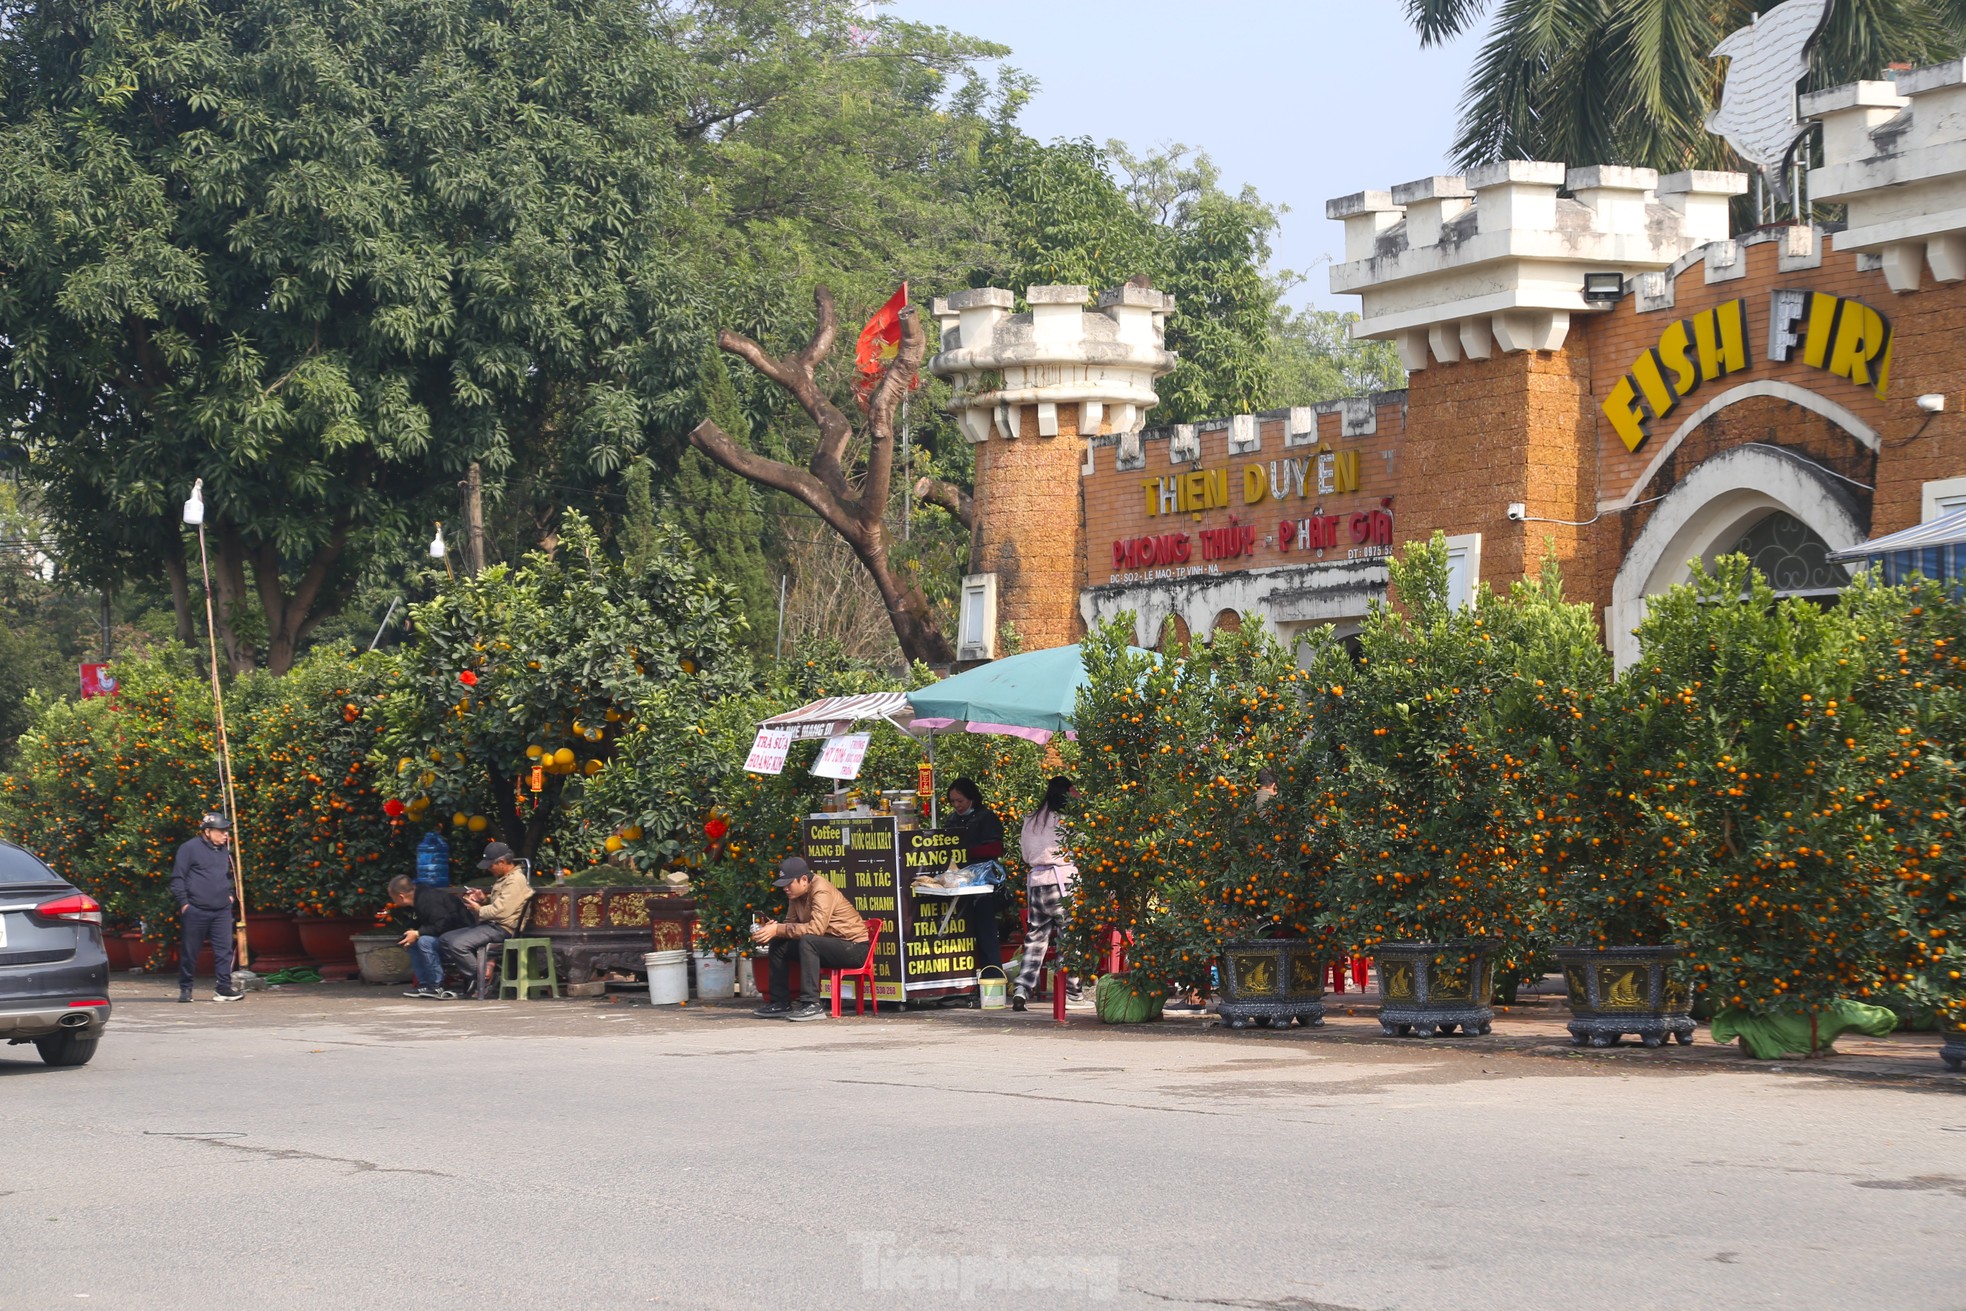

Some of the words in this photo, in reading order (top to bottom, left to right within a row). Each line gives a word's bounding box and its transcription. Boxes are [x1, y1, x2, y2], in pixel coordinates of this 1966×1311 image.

[1602, 298, 1752, 453] FISH
[1768, 289, 1894, 400] FIR
[1243, 442, 1360, 504] DUYÊN
[1112, 532, 1193, 570] PHONG
[1363, 546, 1382, 557] 0975
[1155, 568, 1172, 580] MAO
[1176, 567, 1186, 578] TP
[1187, 565, 1203, 576] VINH
[1208, 564, 1219, 574] NA
[801, 723, 825, 738] MANG
[810, 825, 841, 840] Coffee
[911, 834, 960, 848] Coffee
[808, 845, 833, 857] MANG
[835, 844, 845, 857] ĐI
[905, 850, 948, 867] MANG
[855, 870, 872, 887] TRÀ
[873, 866, 891, 887] TẮC
[855, 894, 868, 911] TRÀ
[869, 896, 894, 911] CHANH
[920, 902, 938, 917] ME
[878, 918, 894, 933] ÀO
[913, 920, 938, 937] TRÀ
[883, 942, 896, 956] LEO
[907, 938, 931, 957] TRÀ
[933, 937, 974, 955] CHANH
[908, 958, 950, 975] CHANH
[953, 956, 975, 971] LEO
